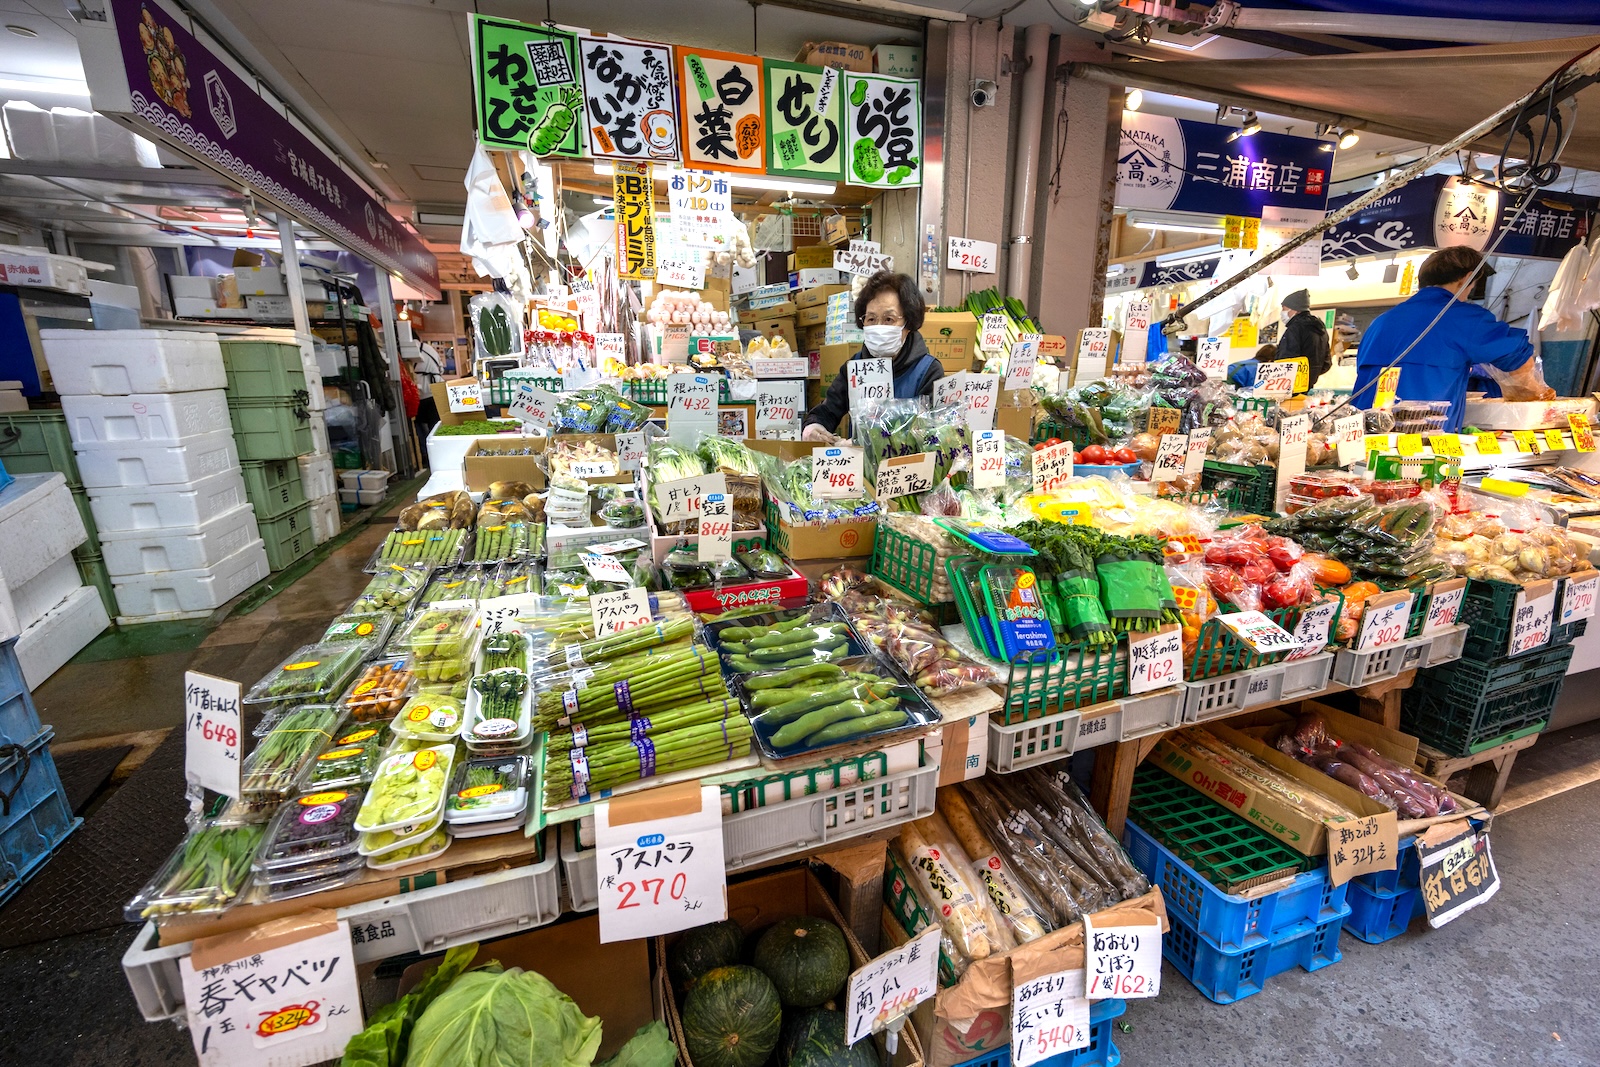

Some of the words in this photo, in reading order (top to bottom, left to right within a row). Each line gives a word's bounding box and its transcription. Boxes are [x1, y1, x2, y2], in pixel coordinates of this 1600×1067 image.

[487, 43, 539, 138] わさび
[586, 45, 645, 155] ながいも
[694, 65, 754, 160] 白菜
[777, 73, 839, 164] せり
[857, 87, 918, 169] そら豆
[1128, 158, 1145, 182] 高
[1191, 151, 1303, 194] 三浦商店
[671, 174, 728, 195] おトク市
[1459, 213, 1470, 231] 高
[1498, 207, 1576, 239] 三浦商店
[836, 250, 892, 273] にんにく
[961, 253, 983, 266] 216
[849, 264, 871, 275] 2160
[1129, 317, 1147, 329] 270
[985, 333, 1002, 346] 864
[1089, 341, 1105, 352] 162
[852, 358, 890, 376] 小松菜
[1016, 366, 1032, 377] 216
[1201, 358, 1226, 370] 324
[673, 381, 719, 395] 根みつば
[862, 384, 884, 400] 108
[936, 377, 957, 396] 春菊
[1264, 377, 1292, 391] 270
[1377, 377, 1399, 393] 400
[516, 391, 546, 407] わらび
[683, 396, 711, 410] 432
[758, 392, 798, 407] 葉わさび
[943, 390, 963, 405] 162
[967, 394, 990, 410] 162
[525, 404, 547, 419] 486
[768, 406, 794, 420] 270
[1285, 431, 1303, 445] 216
[1345, 429, 1363, 442] 270
[1189, 440, 1208, 451] 270
[815, 455, 855, 466] みょうが
[980, 457, 1004, 471] 324
[829, 472, 856, 489] 486
[908, 478, 927, 493] 162
[668, 484, 701, 501] 甘とう
[701, 500, 730, 518] 空豆
[701, 521, 730, 537] 864
[597, 593, 632, 606] メキシコ産
[1572, 594, 1593, 611] 270
[486, 607, 521, 621] こごみ
[597, 602, 640, 620] アスパラ
[1367, 609, 1396, 630] 人参
[1433, 605, 1454, 627] 216
[1514, 610, 1554, 638] 新玉ねぎ
[1373, 625, 1401, 647] 302
[1522, 631, 1543, 650] 270
[1147, 658, 1174, 682] 162
[186, 682, 239, 717] 行者にんにく
[202, 719, 238, 748] 648
[610, 841, 695, 875] アスパラ
[1351, 847, 1376, 867] 324
[1446, 849, 1469, 872] 324
[616, 872, 687, 911] 270
[1424, 855, 1490, 911] 紅はるか
[1092, 931, 1141, 953] あおもり
[221, 953, 265, 981] 神奈川県
[1095, 953, 1135, 974] ごぼう
[195, 956, 341, 1019] 春キャベツ
[1018, 975, 1066, 1003] あおもり
[1113, 973, 1144, 995] 162
[855, 977, 901, 1014] 南瓜
[1014, 997, 1064, 1034] 長いも
[1036, 1023, 1075, 1054] 540
